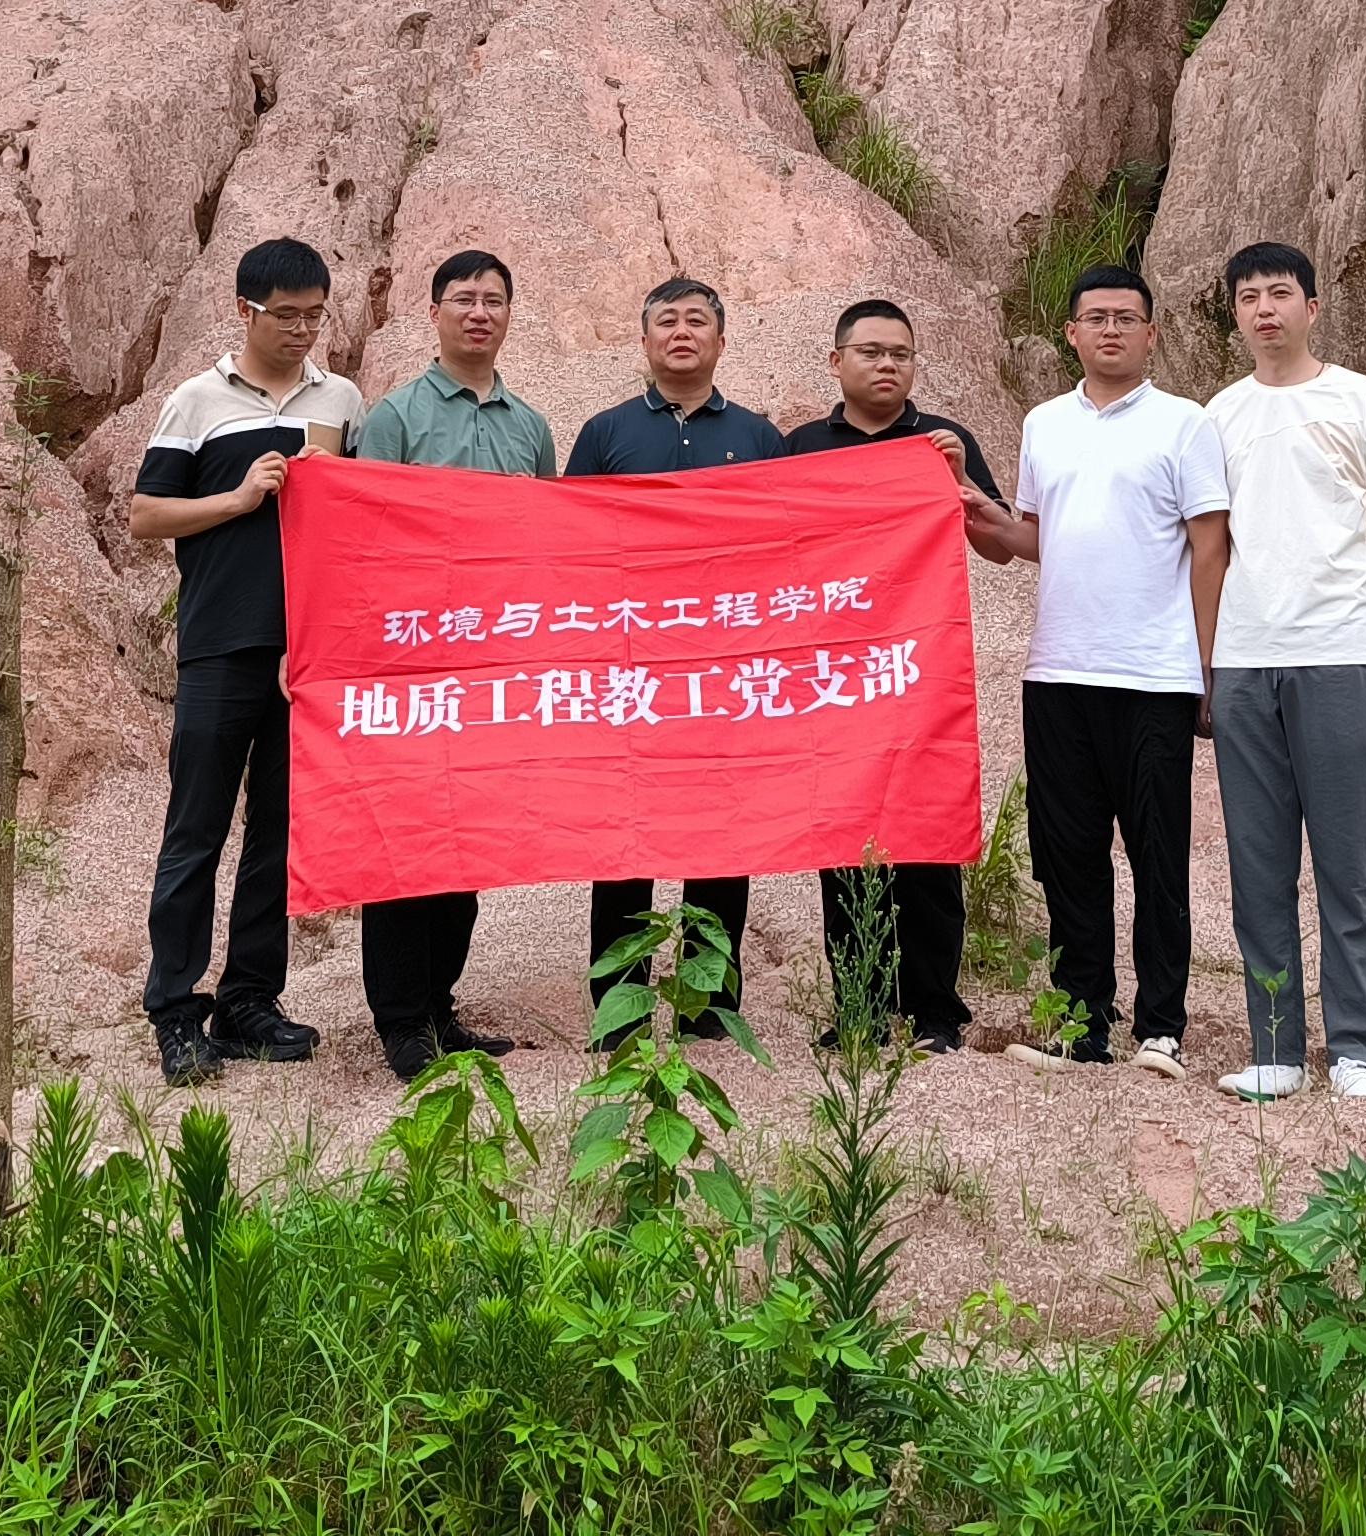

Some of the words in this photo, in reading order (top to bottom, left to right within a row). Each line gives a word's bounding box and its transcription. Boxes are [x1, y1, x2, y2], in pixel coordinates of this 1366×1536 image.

[382, 576, 874, 647] 环境与土木工程学院
[336, 639, 921, 738] 地质工程教工党支部
